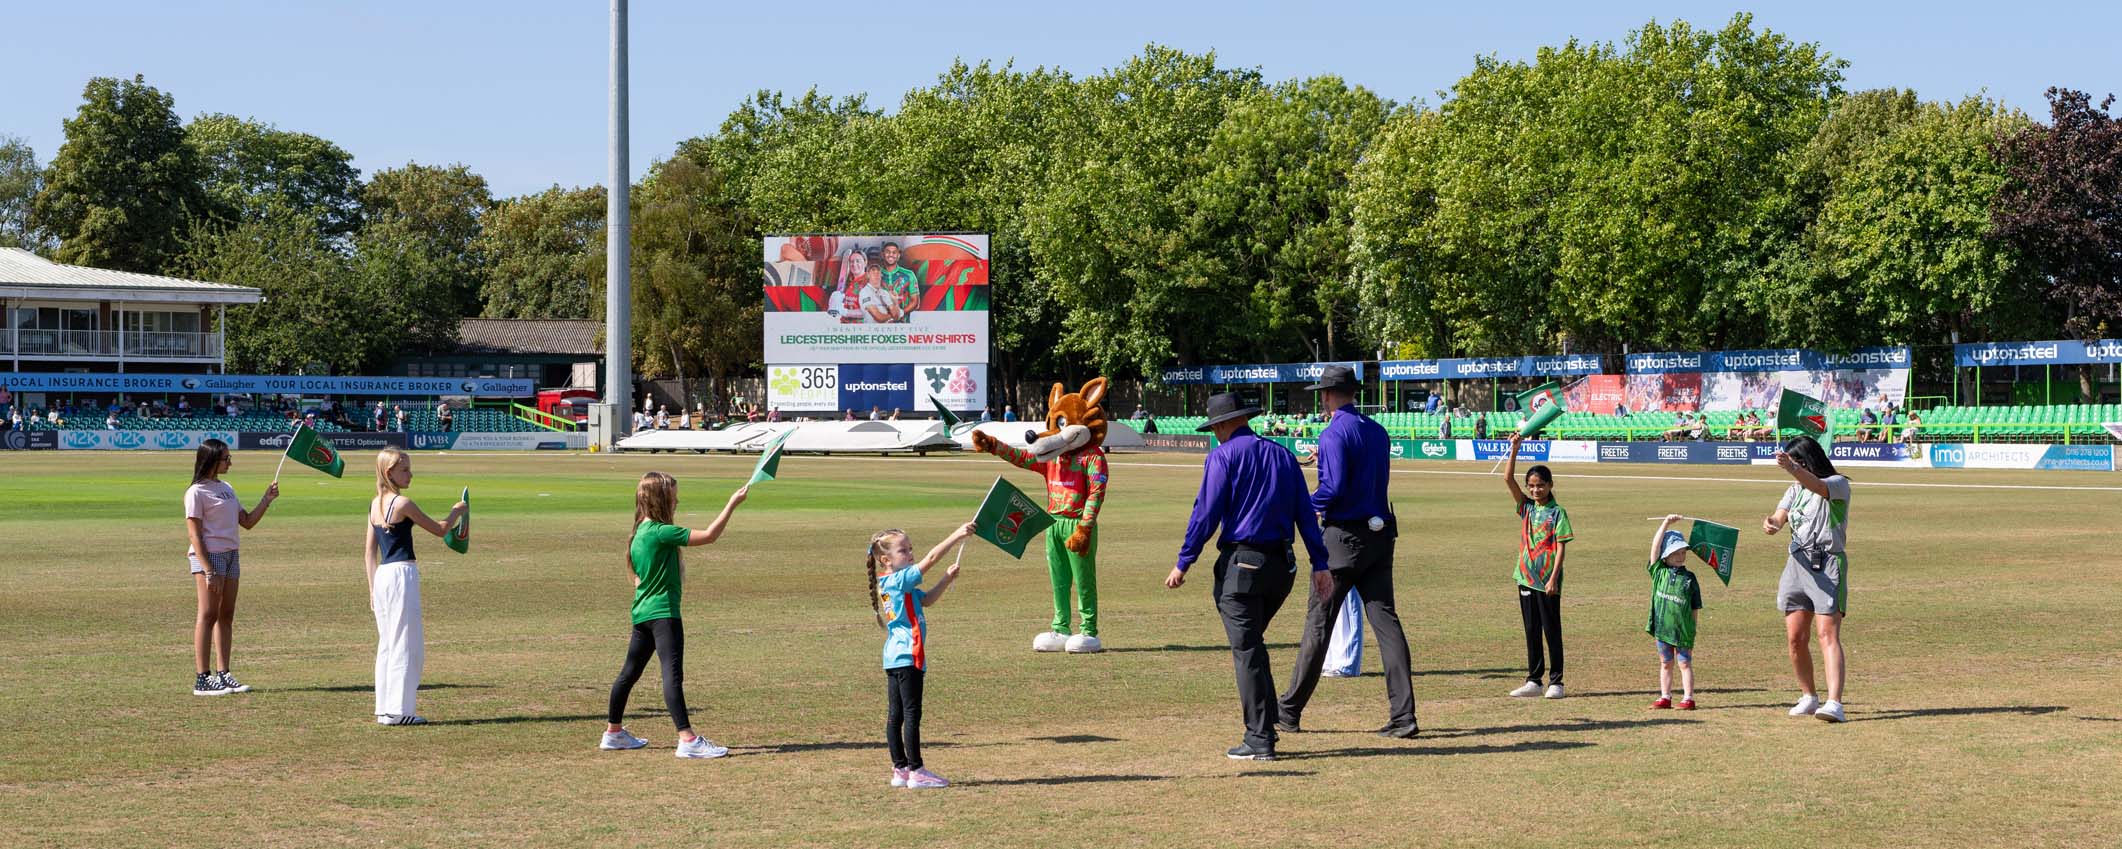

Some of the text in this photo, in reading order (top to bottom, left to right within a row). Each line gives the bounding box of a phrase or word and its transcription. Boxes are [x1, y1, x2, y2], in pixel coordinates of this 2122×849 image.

[781, 334, 976, 344] LEICESTERSHIRE FOXES NEW SHIRTS
[1972, 344, 2058, 363] uptonsteel
[1536, 358, 1599, 373] uptonsteel
[1629, 355, 1701, 371] uptonsteel
[1725, 352, 1801, 370] uptonsteel
[1220, 366, 1278, 379] uptonsteel
[1383, 363, 1440, 377] uptonsteel
[1457, 360, 1517, 375] uptonsteel
[3, 377, 173, 388] LOCAL INSURANCE BROKER
[801, 367, 836, 389] 365
[205, 378, 256, 391] Gallagher
[264, 380, 453, 391] YOUR LOCAL INSURANCE BROKER
[482, 382, 528, 394] Gallagher
[845, 381, 908, 393] uptonsteel
[1591, 393, 1622, 401] ELECTRIC
[67, 431, 96, 445] M2K
[112, 431, 140, 445] M2K
[158, 431, 186, 445] M2K
[357, 438, 388, 447] Opticians
[427, 435, 449, 444] WBR
[1180, 441, 1207, 449] COMPANY
[1421, 441, 1447, 456] Carlsberg
[1477, 442, 1499, 452] VALE
[1755, 446, 1772, 456] THE
[1601, 447, 1629, 457] FREETHS
[1658, 448, 1688, 458] FREETHS
[1717, 448, 1748, 458] FREETHS
[1834, 446, 1852, 457] GET
[1853, 447, 1881, 458] AWAY
[1934, 446, 1962, 463] ima
[1968, 451, 2031, 462] ARCHITECTS
[1010, 494, 1036, 515] FOXES
